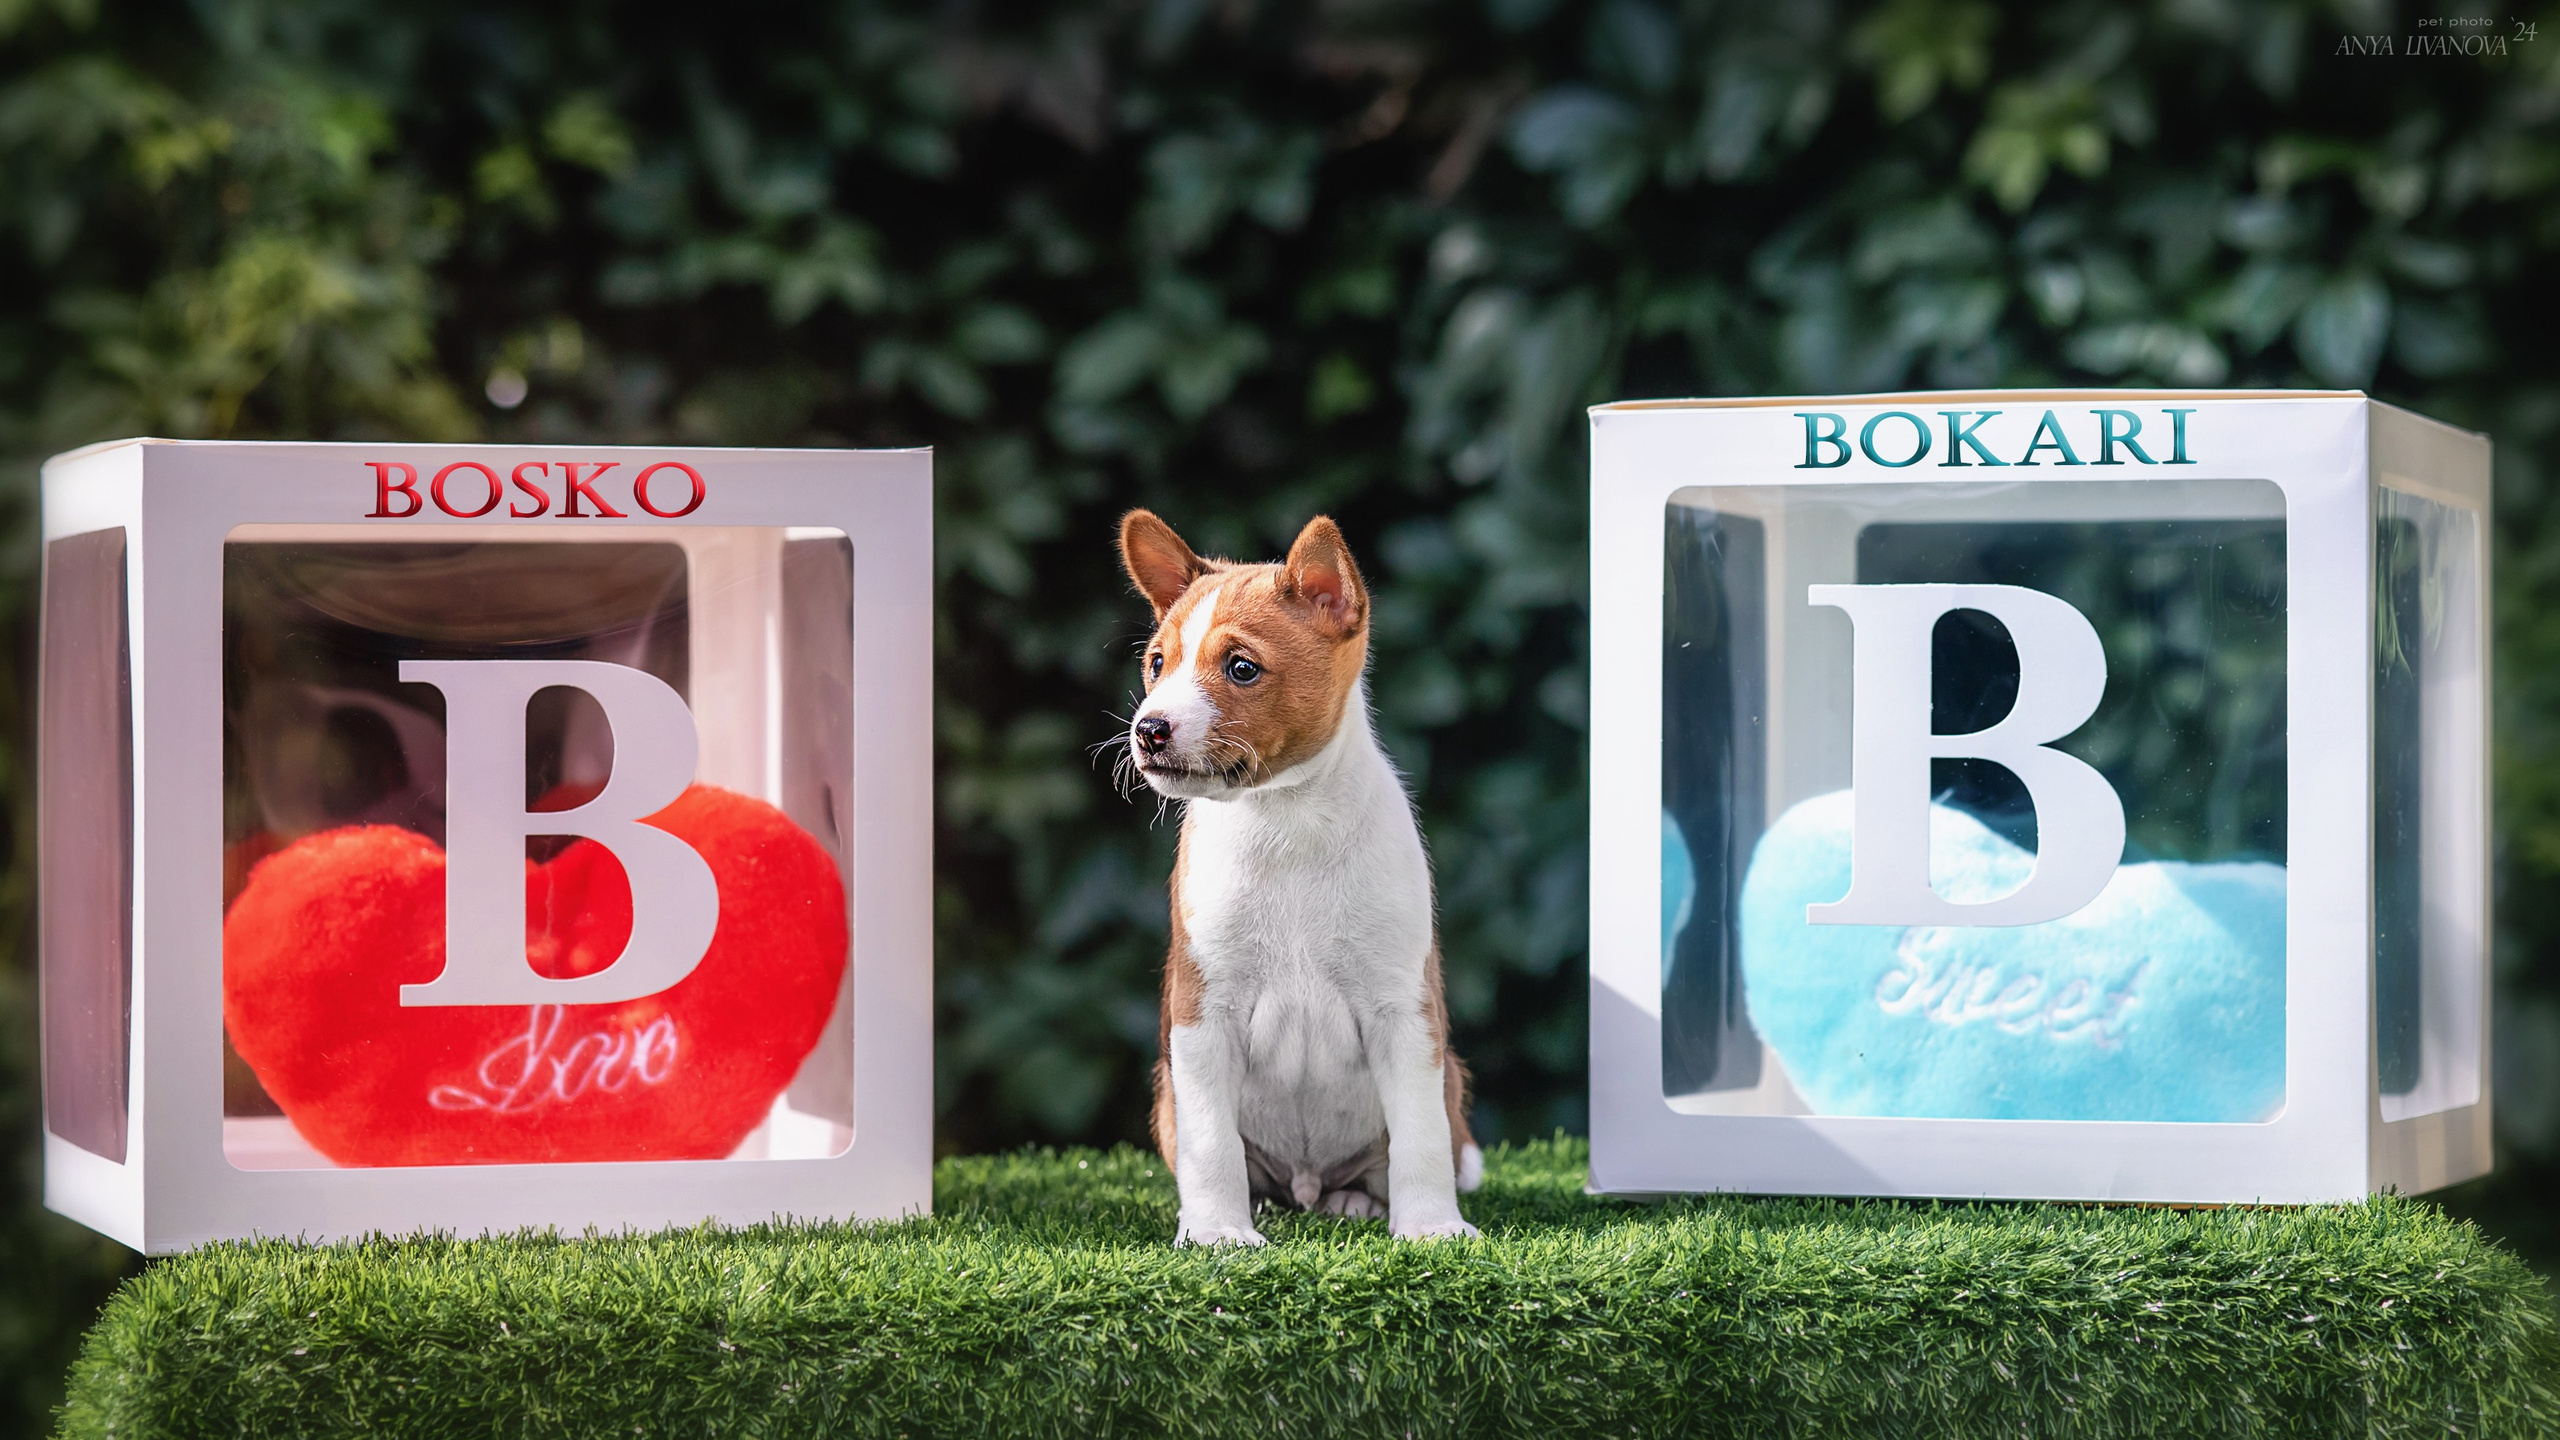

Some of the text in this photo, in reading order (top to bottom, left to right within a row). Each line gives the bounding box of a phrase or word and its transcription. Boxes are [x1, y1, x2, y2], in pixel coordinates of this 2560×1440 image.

[364, 461, 706, 518] BOSKO
[1793, 408, 2198, 469] BOKARI
[399, 660, 720, 1007] B
[1806, 583, 2126, 927] B
